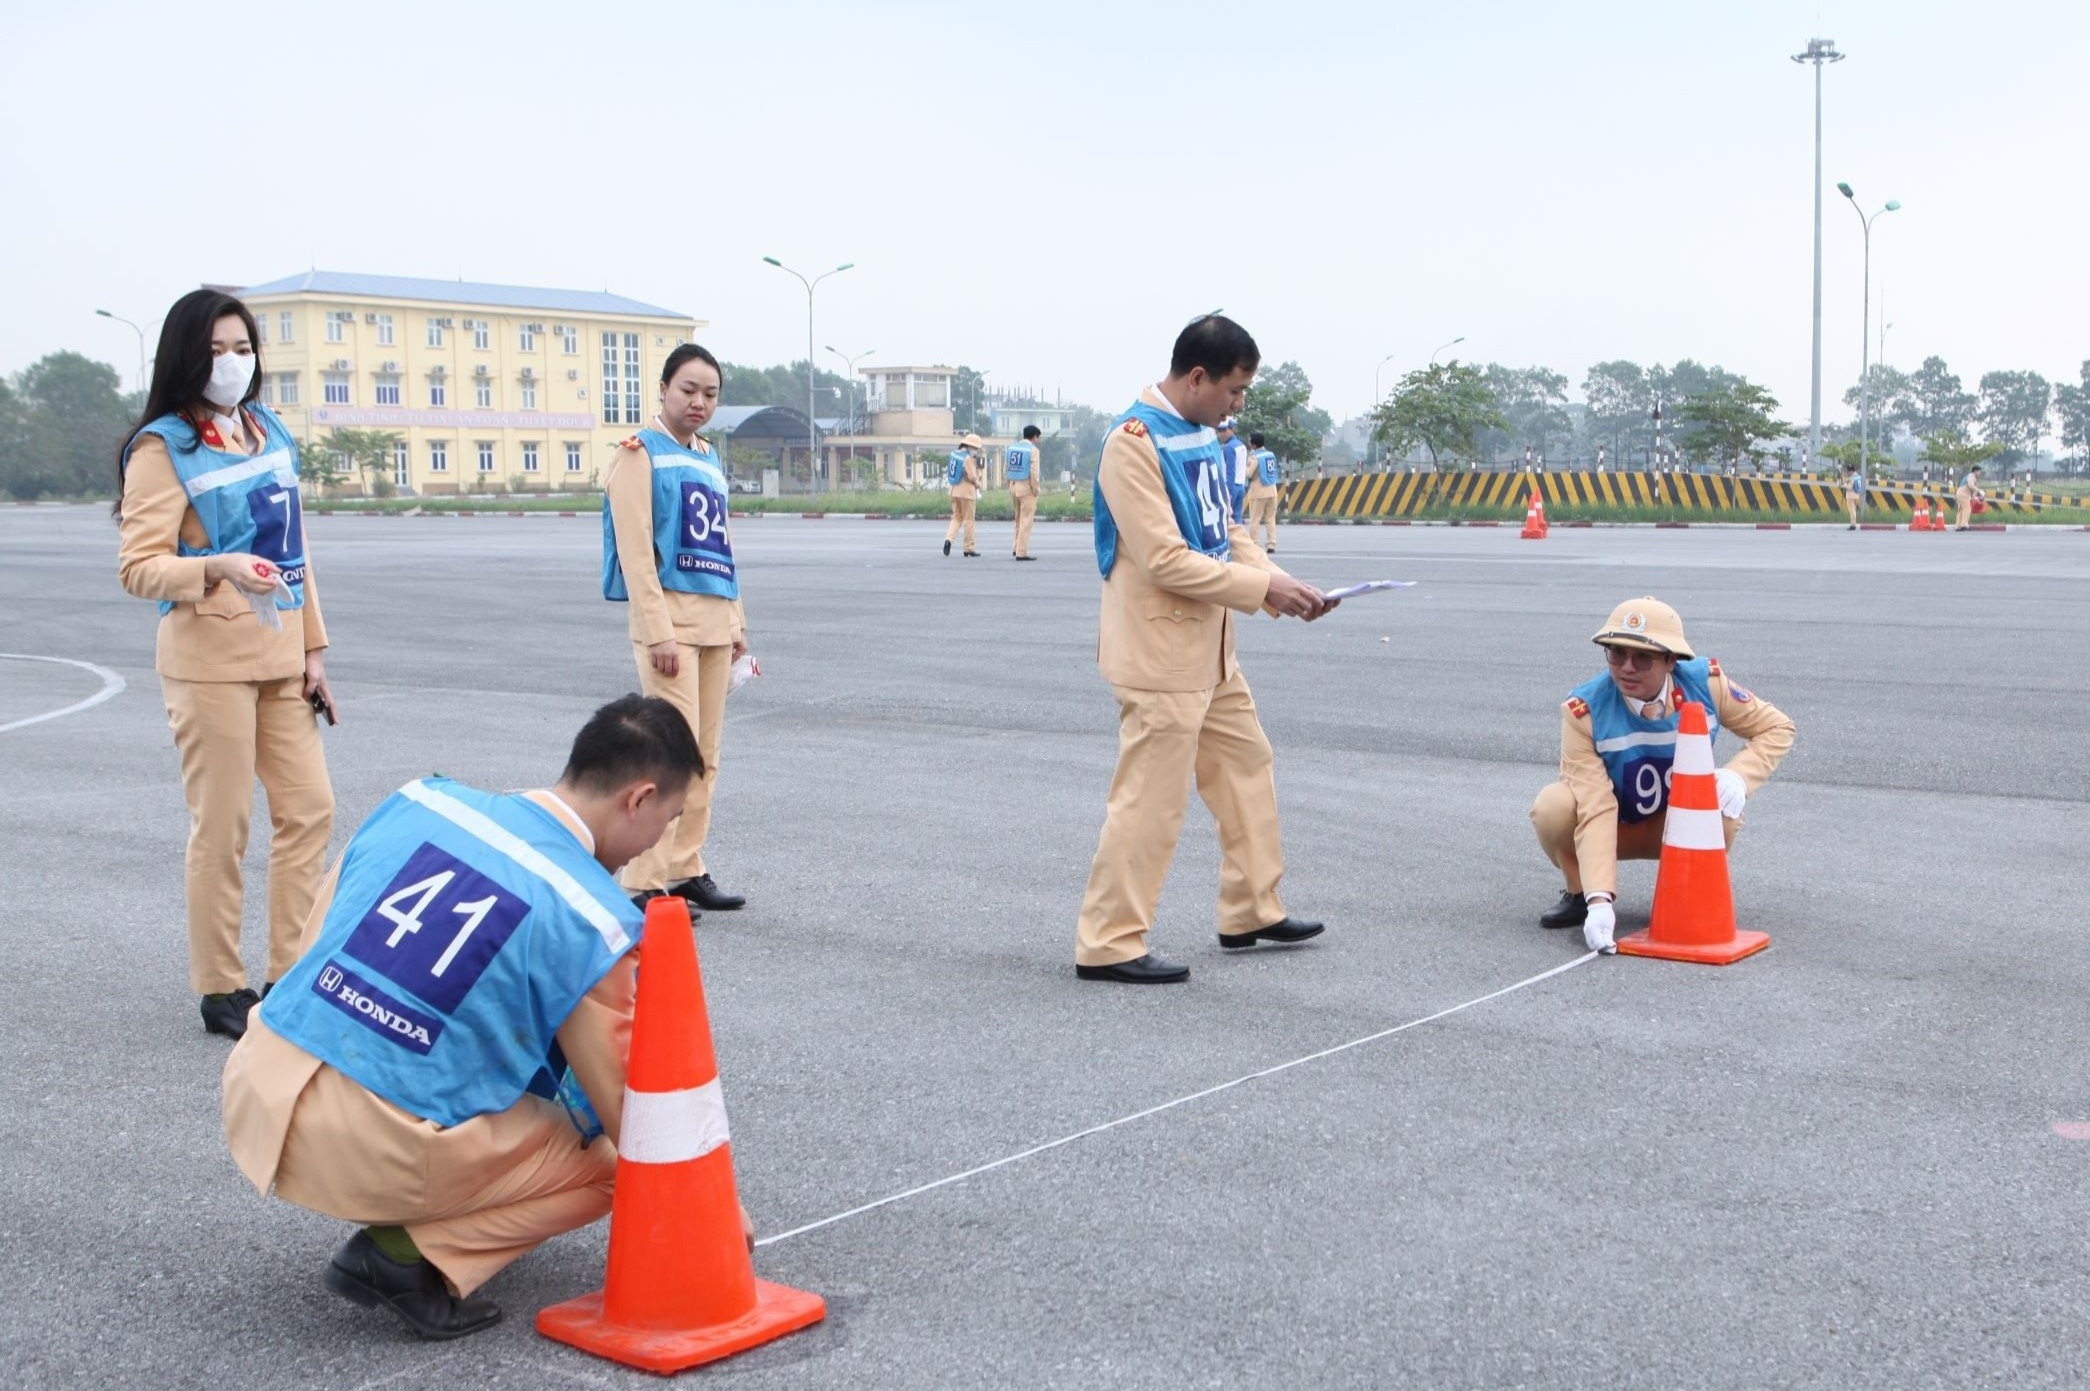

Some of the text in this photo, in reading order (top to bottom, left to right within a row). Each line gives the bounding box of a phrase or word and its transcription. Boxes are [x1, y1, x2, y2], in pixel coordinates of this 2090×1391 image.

[1010, 452, 1021, 465] 51
[269, 490, 291, 553] 7
[689, 491, 728, 545] 34
[694, 560, 732, 575] HONDA
[376, 870, 498, 978] 41
[337, 984, 432, 1046] HONDA
